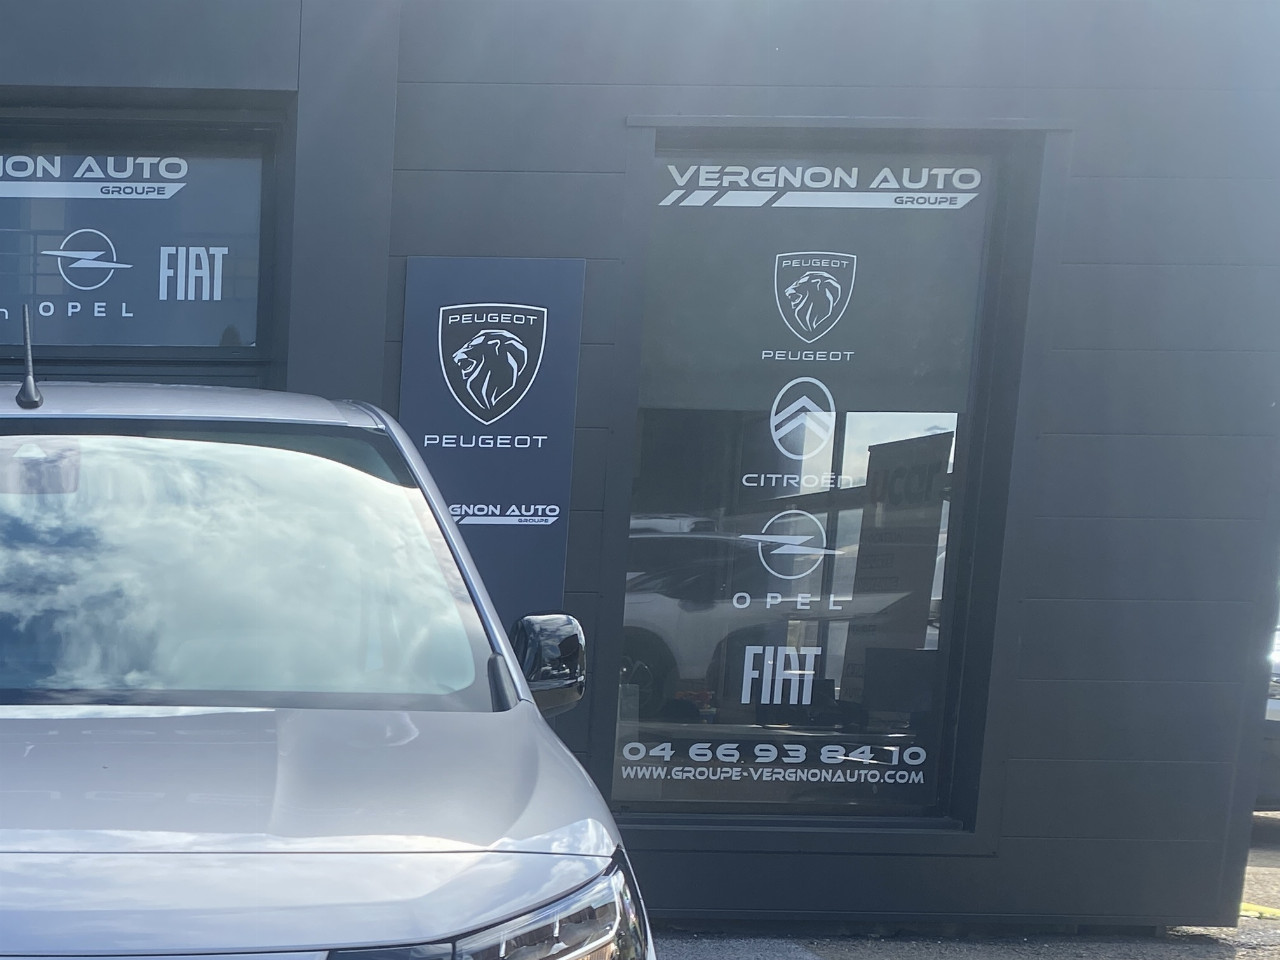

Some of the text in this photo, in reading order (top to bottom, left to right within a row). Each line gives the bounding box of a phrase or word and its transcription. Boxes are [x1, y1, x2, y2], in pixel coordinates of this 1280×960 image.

[72, 155, 189, 180] AUTO
[667, 164, 982, 190] VERGNON AUTO
[100, 185, 166, 196] GROUPE
[893, 196, 958, 206] GROUPE
[782, 258, 850, 269] PEUGEOT
[159, 246, 229, 301] FIAT
[38, 301, 134, 318] OPEL
[448, 313, 538, 326] PEUGEOT
[761, 350, 855, 361] PEUGEOT
[424, 434, 548, 448] PEUGEOT
[448, 504, 561, 517] GNON AUTO
[732, 592, 843, 611] OPEL
[740, 645, 822, 705] FIAT
[622, 742, 928, 766] 04 66 93 84 10
[621, 765, 925, 784] WWW.GROUPE-VERGNONAUTO.COM
